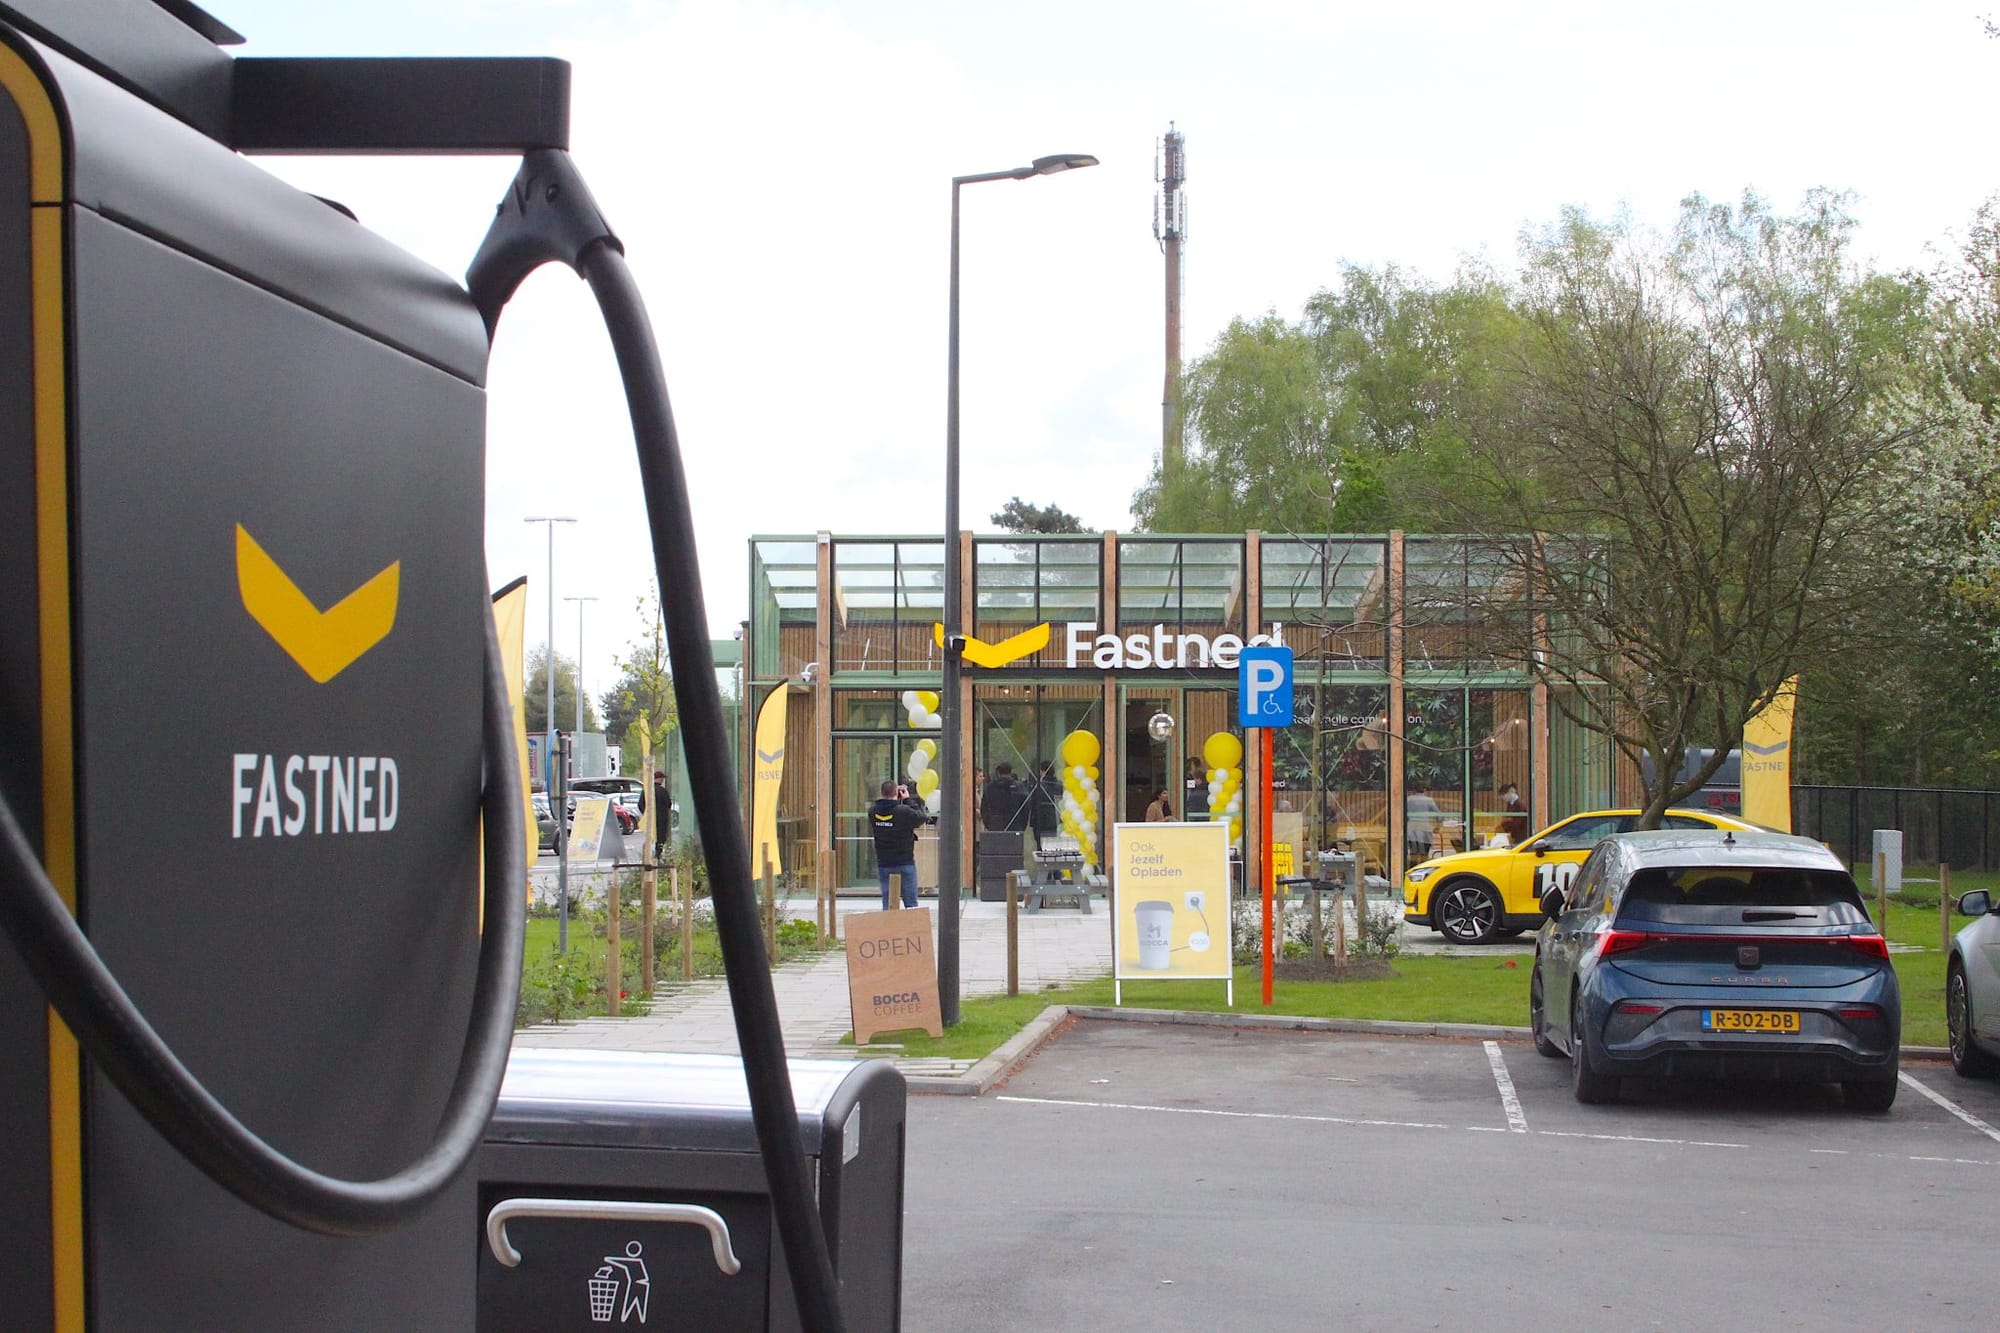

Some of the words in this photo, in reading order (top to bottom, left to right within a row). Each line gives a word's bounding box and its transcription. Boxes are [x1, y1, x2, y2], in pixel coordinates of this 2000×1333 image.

[1246, 659, 1285, 715] P
[1744, 761, 1787, 771] FASTNE
[232, 753, 399, 838] FASTNED
[1130, 841, 1155, 853] Ook
[1131, 853, 1164, 865] Jezelf
[1130, 866, 1183, 879] Opladen
[859, 935, 923, 959] OPEN
[873, 991, 921, 1006] BOCCA
[873, 1003, 923, 1017] COFFEE
[1715, 1012, 1794, 1029] R-302-DB
